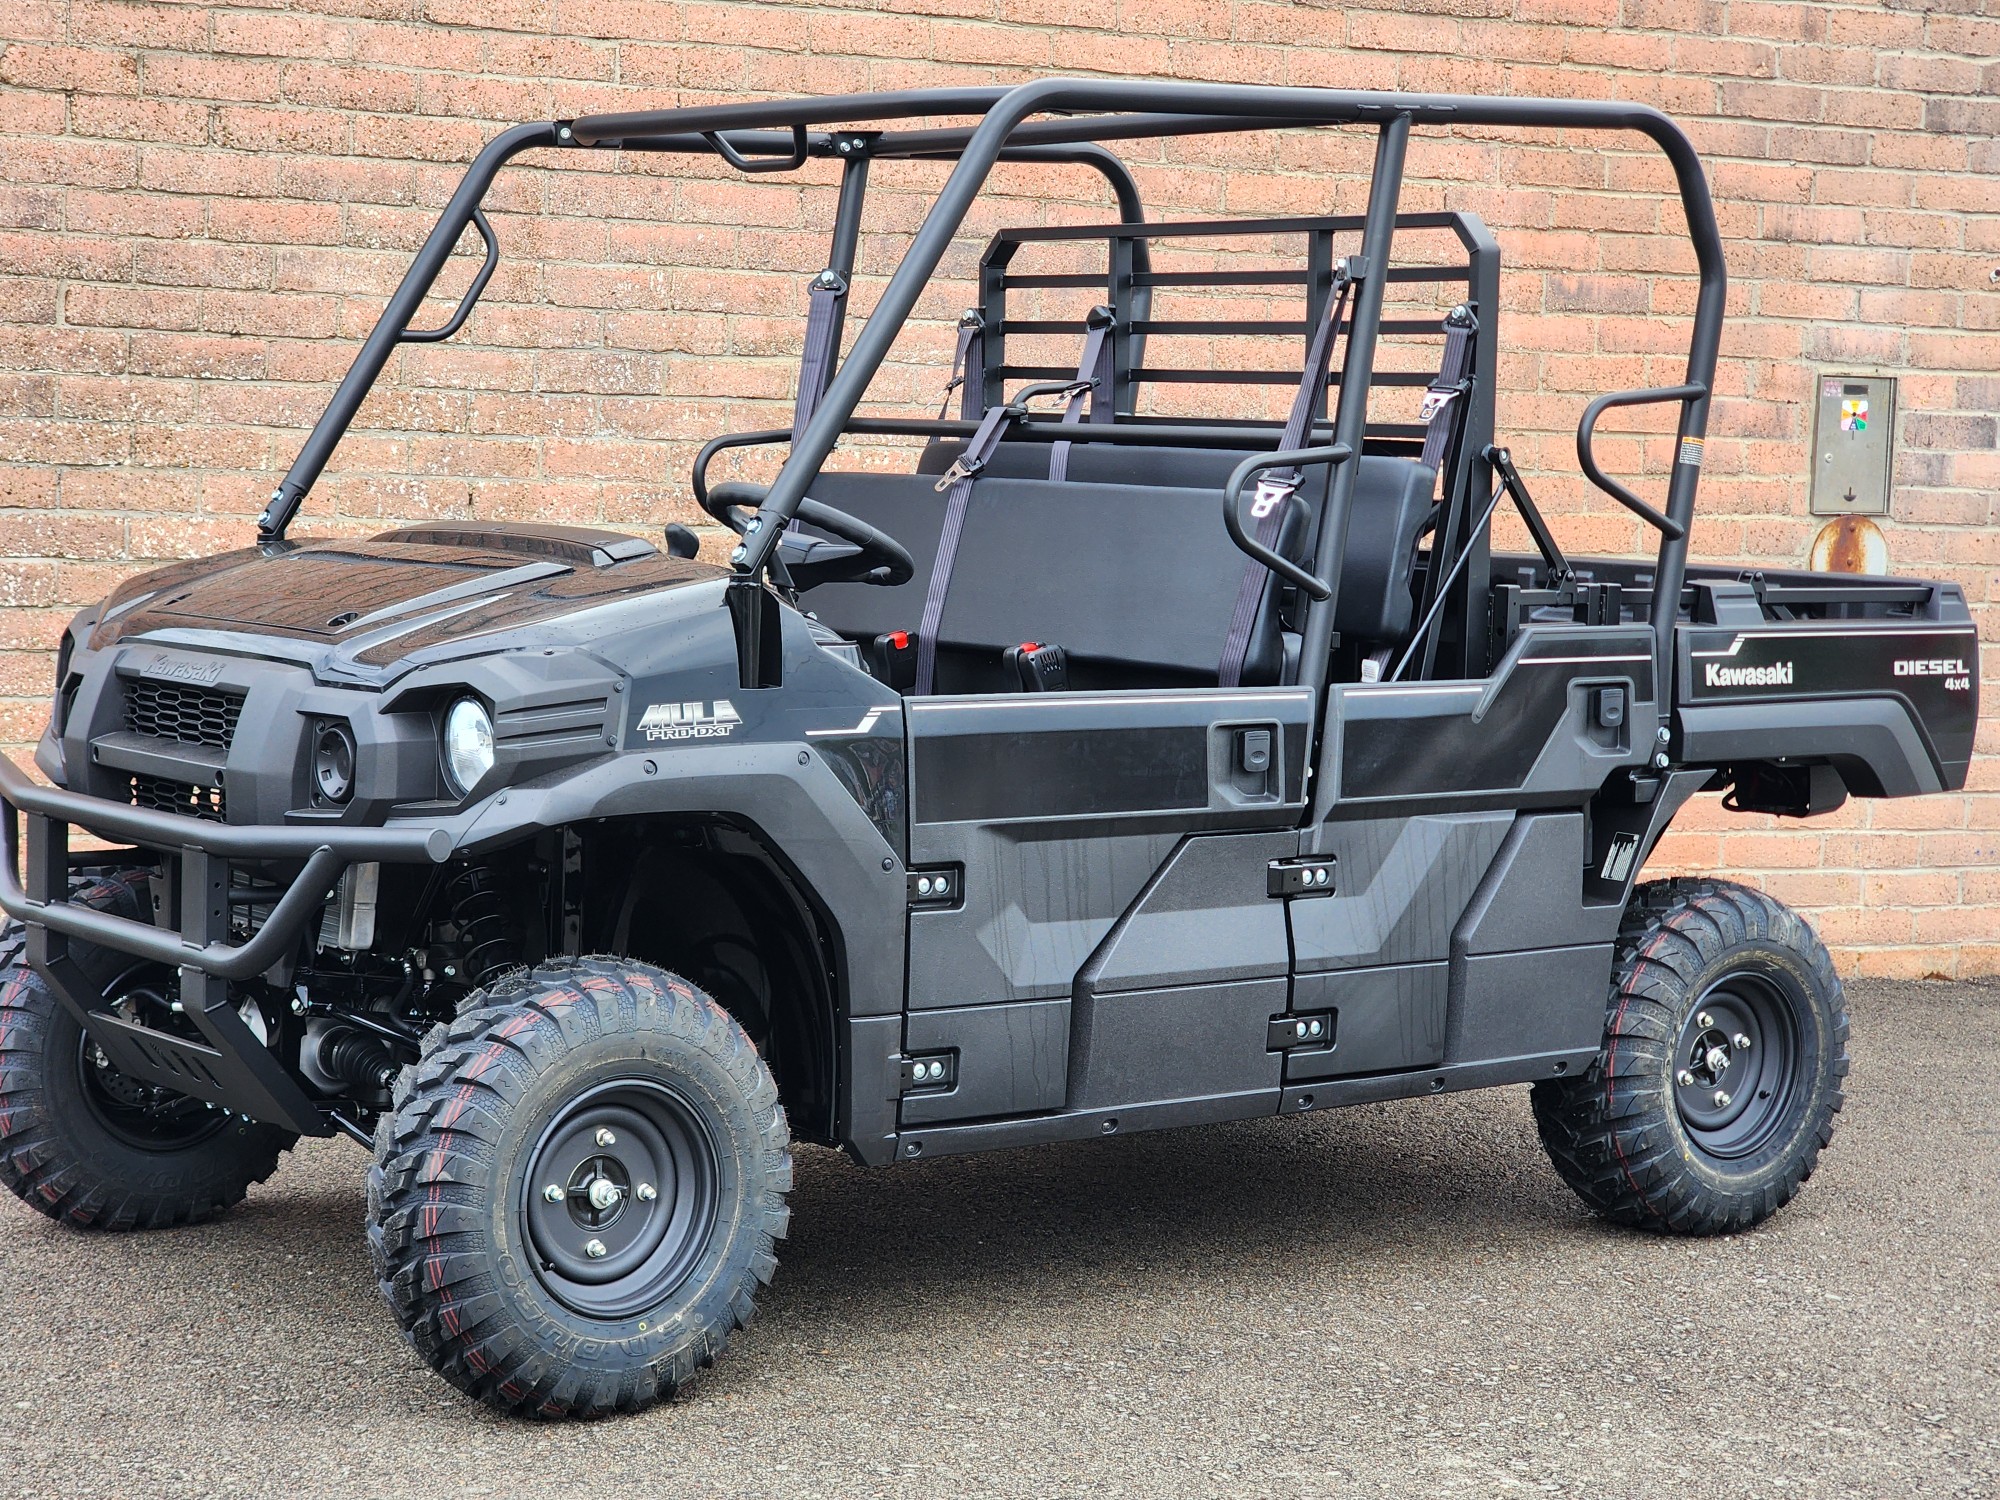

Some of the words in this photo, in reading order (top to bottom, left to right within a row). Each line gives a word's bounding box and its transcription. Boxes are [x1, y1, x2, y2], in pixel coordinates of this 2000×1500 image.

[144, 654, 227, 682] Kawasaki
[1705, 661, 1793, 687] Kawasaki
[1893, 660, 1970, 676] DIESEL
[1944, 677, 1970, 691] 4x4
[637, 699, 743, 730] MULE
[646, 725, 734, 741] PRO-DXT
[497, 1253, 605, 1361] DURO
